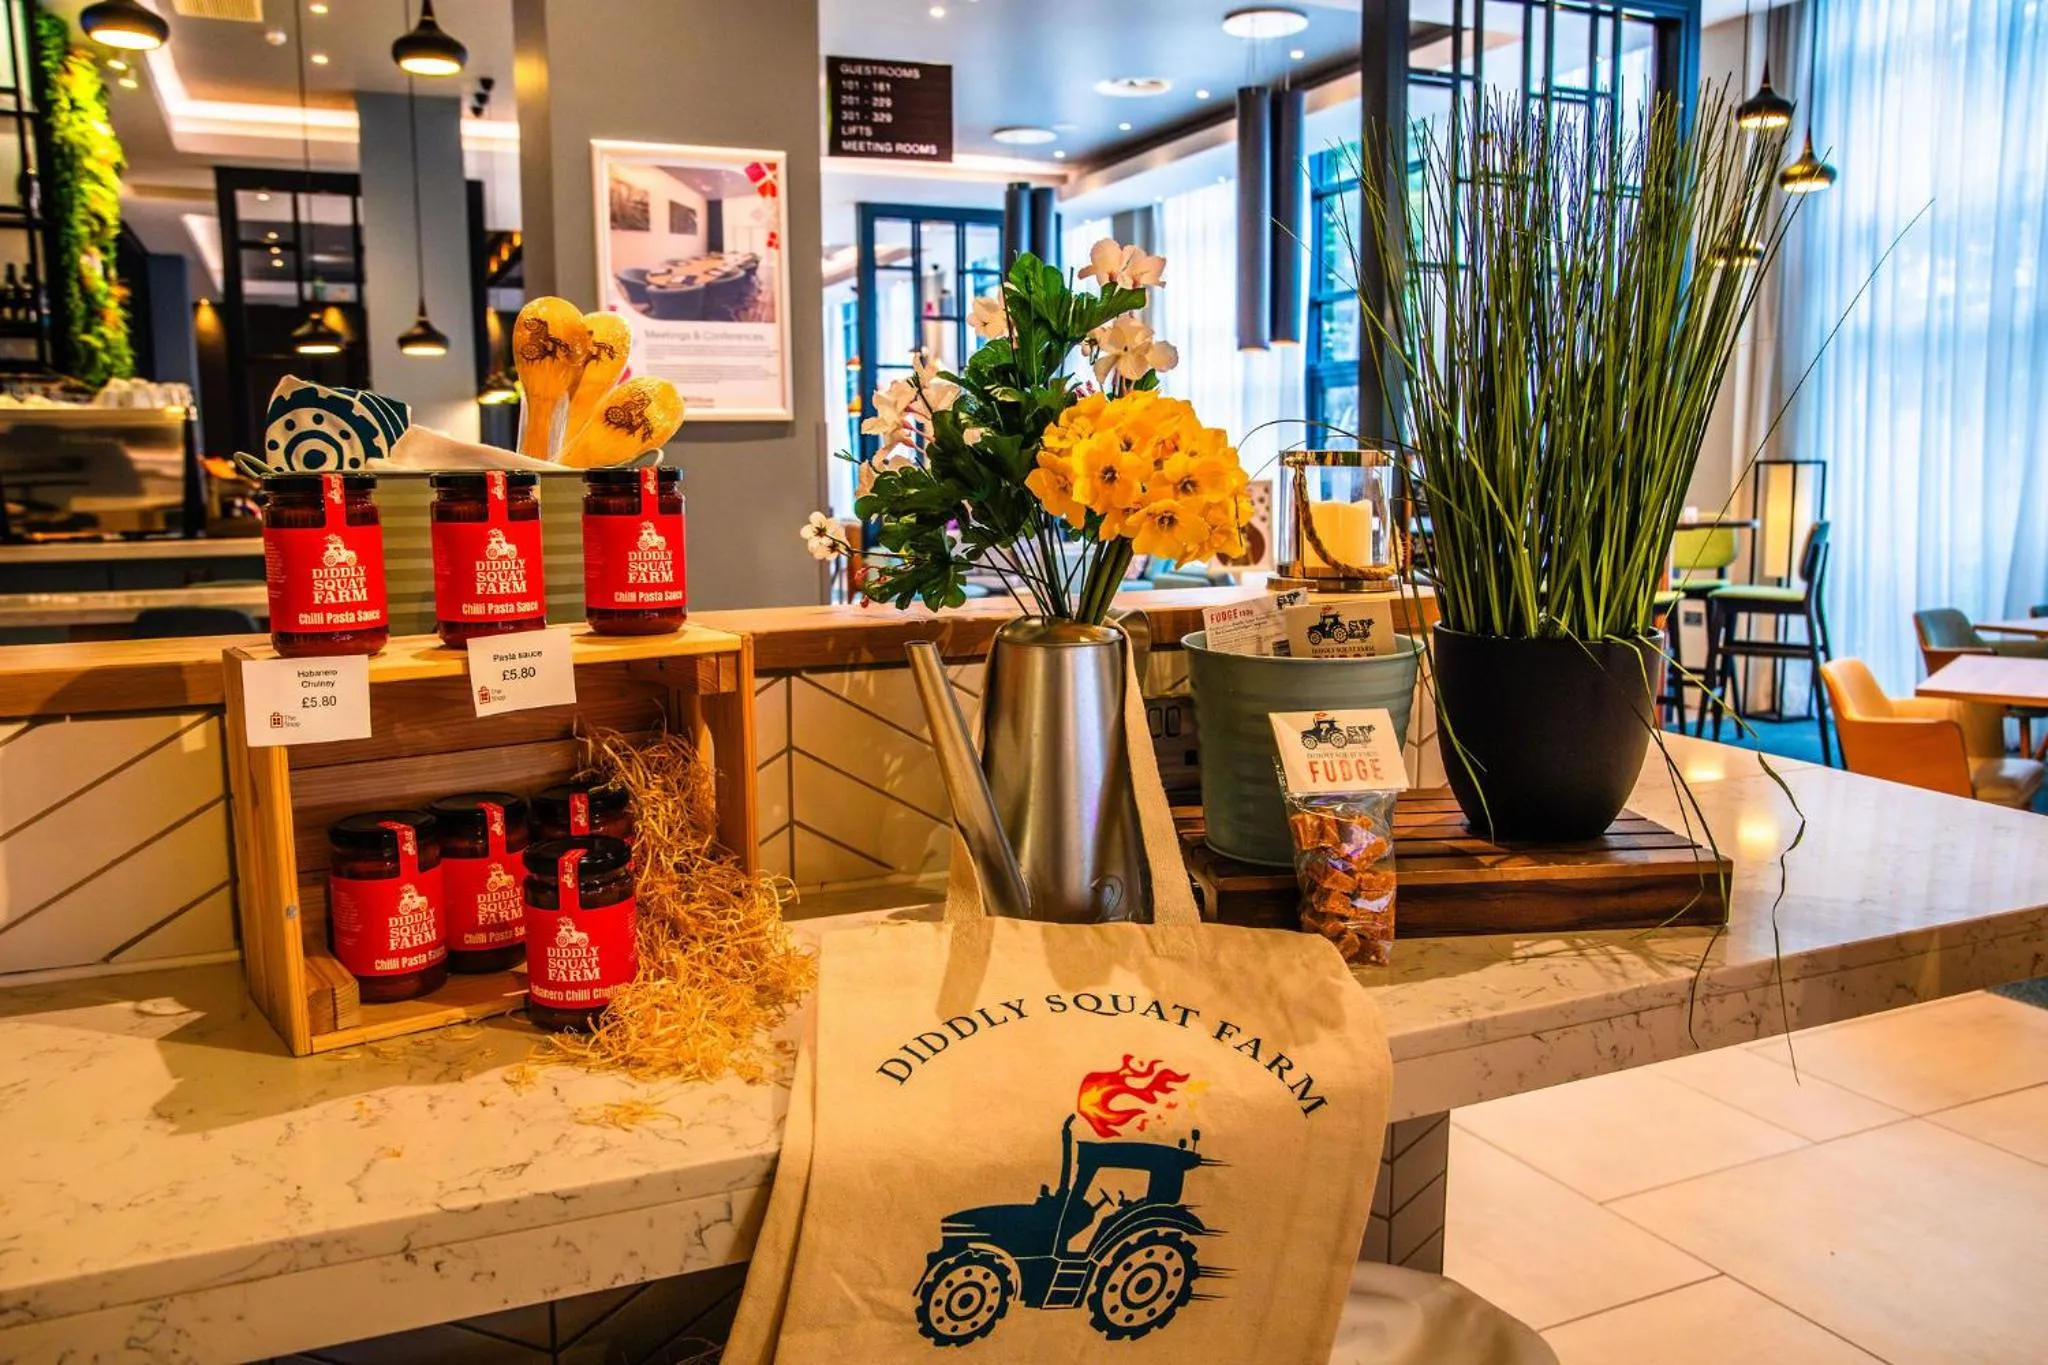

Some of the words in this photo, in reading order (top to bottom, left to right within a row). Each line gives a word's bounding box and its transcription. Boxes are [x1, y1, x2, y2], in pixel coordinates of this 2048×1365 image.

[839, 64, 921, 79] GUESTROOMS
[841, 80, 860, 91] 101
[841, 110, 861, 121] 301
[841, 125, 873, 137] LIFTS
[841, 140, 893, 153] MEETING
[895, 143, 938, 155] ROOMS
[644, 330, 691, 341] Meetings
[703, 331, 765, 341] Conferences
[627, 550, 674, 562] DIDDLY
[312, 566, 367, 579] DIDDLY
[475, 559, 526, 572] DIDDLY
[628, 560, 673, 573] SQUAT
[476, 569, 526, 583] SQUAT
[627, 570, 674, 584] FARM
[313, 577, 367, 592] SQUAT
[476, 580, 528, 595] FARM
[313, 588, 369, 604] FARM
[614, 591, 637, 602] Chilli
[638, 591, 664, 602] Pasta
[462, 603, 486, 615] Chilli
[488, 602, 515, 614] Pasta
[299, 612, 324, 625] Chilli
[326, 611, 355, 624] Pasta
[357, 609, 381, 622] Sauce
[1210, 608, 1239, 625] FUDGE
[492, 653, 517, 662] Pasta
[518, 650, 543, 659] sauce
[297, 669, 338, 678] Habanero
[502, 666, 536, 681] £5.80
[302, 695, 337, 709] £5.80
[1308, 758, 1384, 783] FUDGE
[477, 886, 524, 903] DIDDLY
[478, 896, 522, 914] SQUAT
[388, 907, 436, 928] DIDDLY
[478, 905, 524, 926] FARM
[389, 918, 436, 939] SQUAT
[388, 929, 437, 951] FARM
[464, 932, 487, 944] Chilli
[489, 930, 513, 943] Pasta
[547, 946, 600, 958] DIDDLY
[375, 958, 400, 971] Chilli
[401, 953, 427, 968] Pasta
[548, 957, 600, 971] SQUAT
[548, 967, 602, 982] FARM
[566, 989, 591, 1002] Chilli
[876, 998, 1029, 1086] DIDDLY
[1045, 992, 1200, 1029] SQUAT
[1212, 1019, 1329, 1119] FARM
